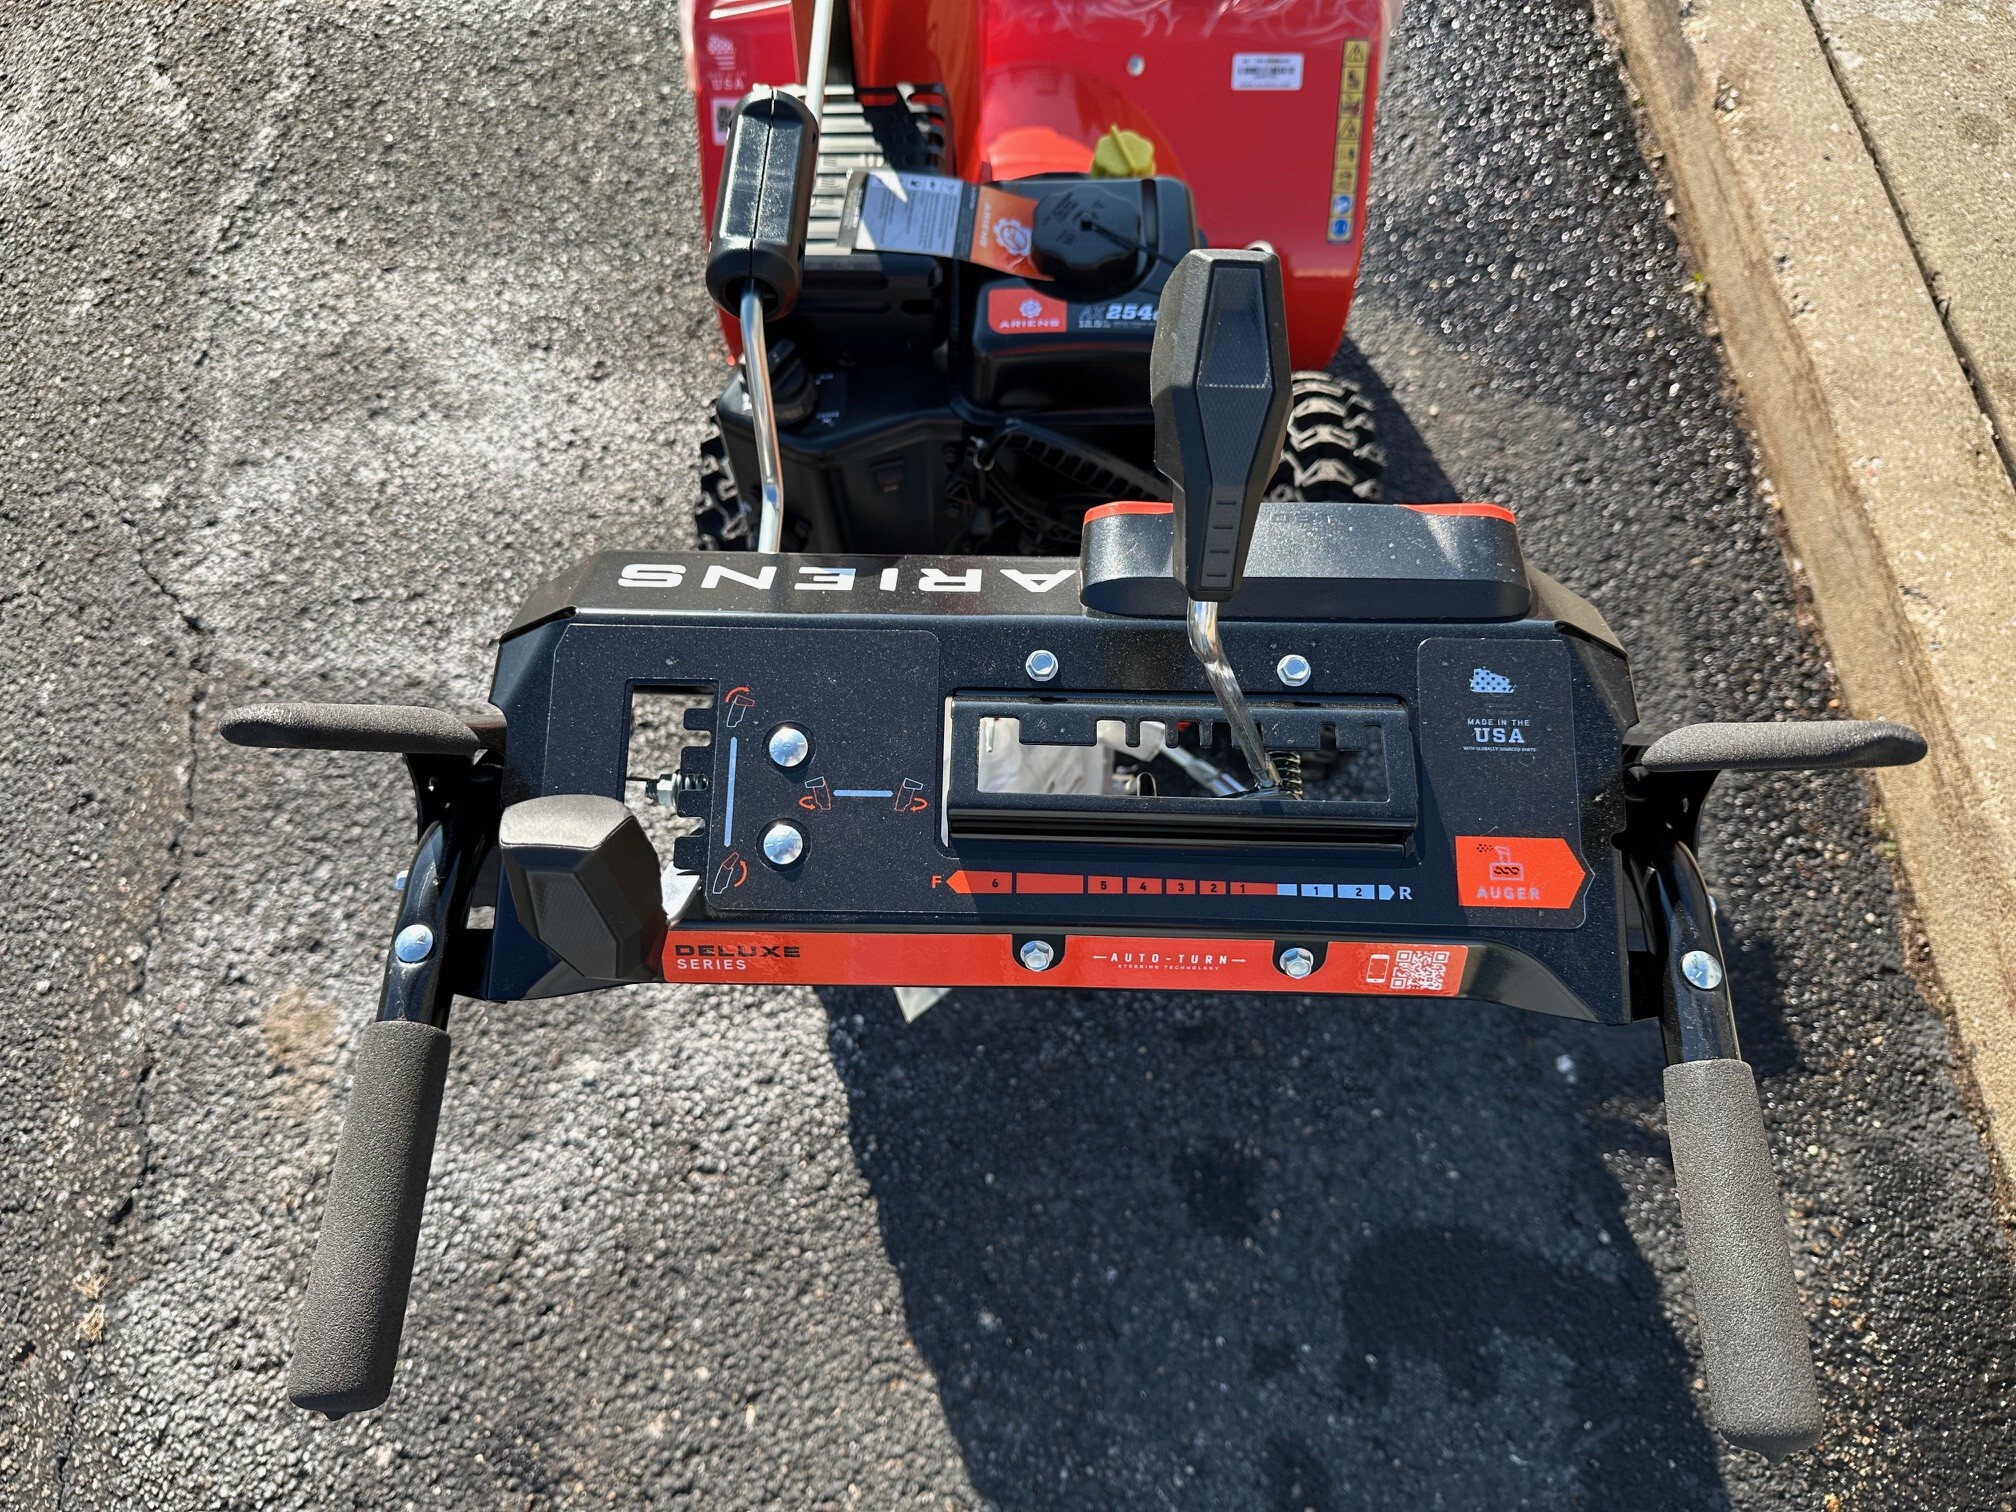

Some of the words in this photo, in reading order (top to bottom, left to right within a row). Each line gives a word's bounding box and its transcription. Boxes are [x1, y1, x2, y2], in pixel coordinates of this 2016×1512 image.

[711, 77, 745, 91] USA
[1000, 318, 1061, 329] ARIENS
[617, 563, 1077, 593] ARIENS
[1467, 718, 1493, 726] MADE
[1511, 719, 1530, 727] THE
[1473, 727, 1525, 744] USA
[931, 875, 942, 889] F
[991, 878, 999, 888] 6
[1100, 880, 1107, 890] 5
[1139, 881, 1147, 891] 4
[1177, 882, 1185, 892] 3
[1210, 883, 1218, 893] 2
[1239, 884, 1246, 894] 1
[1313, 886, 1320, 896] 1
[1355, 887, 1363, 897] 2
[1399, 886, 1413, 900] R
[1477, 886, 1541, 901] AUGER
[674, 944, 801, 958] DELUXE
[677, 958, 747, 970] SERIES
